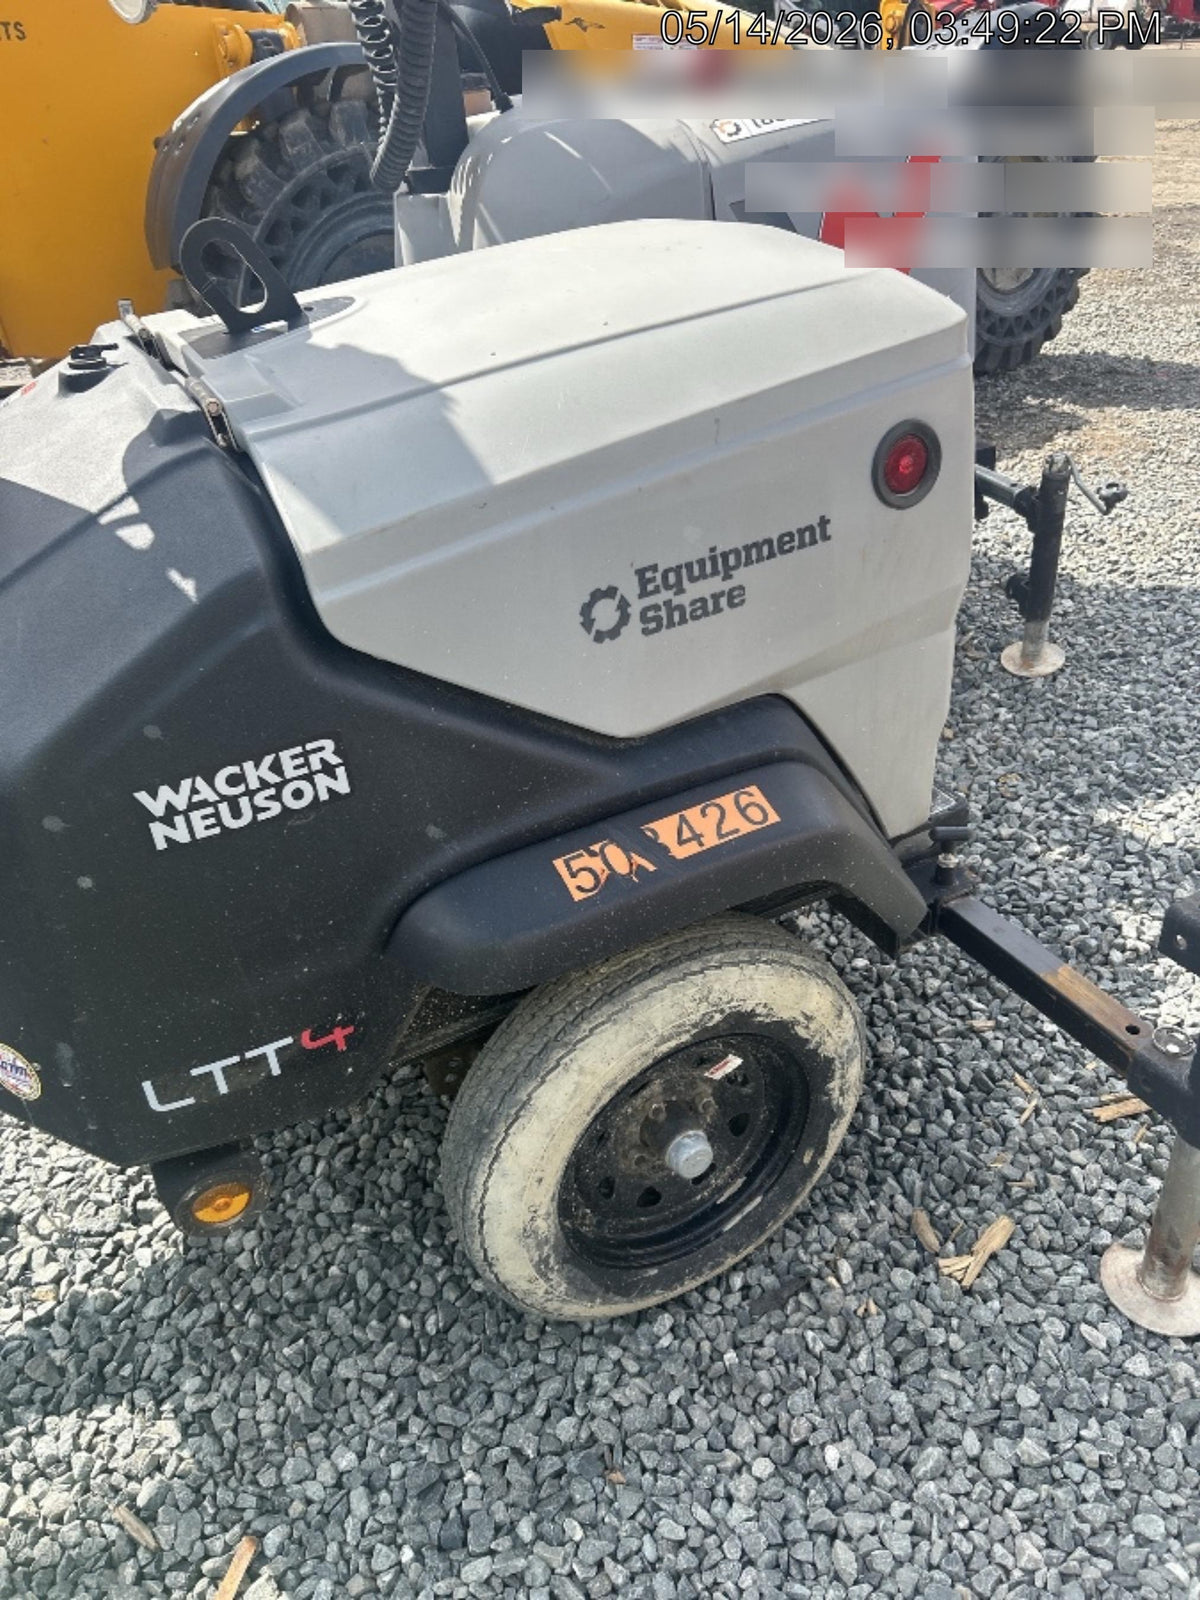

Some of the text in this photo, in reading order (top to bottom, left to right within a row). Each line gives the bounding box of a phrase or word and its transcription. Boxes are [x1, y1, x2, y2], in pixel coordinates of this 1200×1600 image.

[0, 21, 27, 41] TS
[634, 514, 831, 599] Equipment
[639, 584, 746, 636] Share
[132, 738, 343, 818] WACKER
[148, 765, 351, 850] NEUSON
